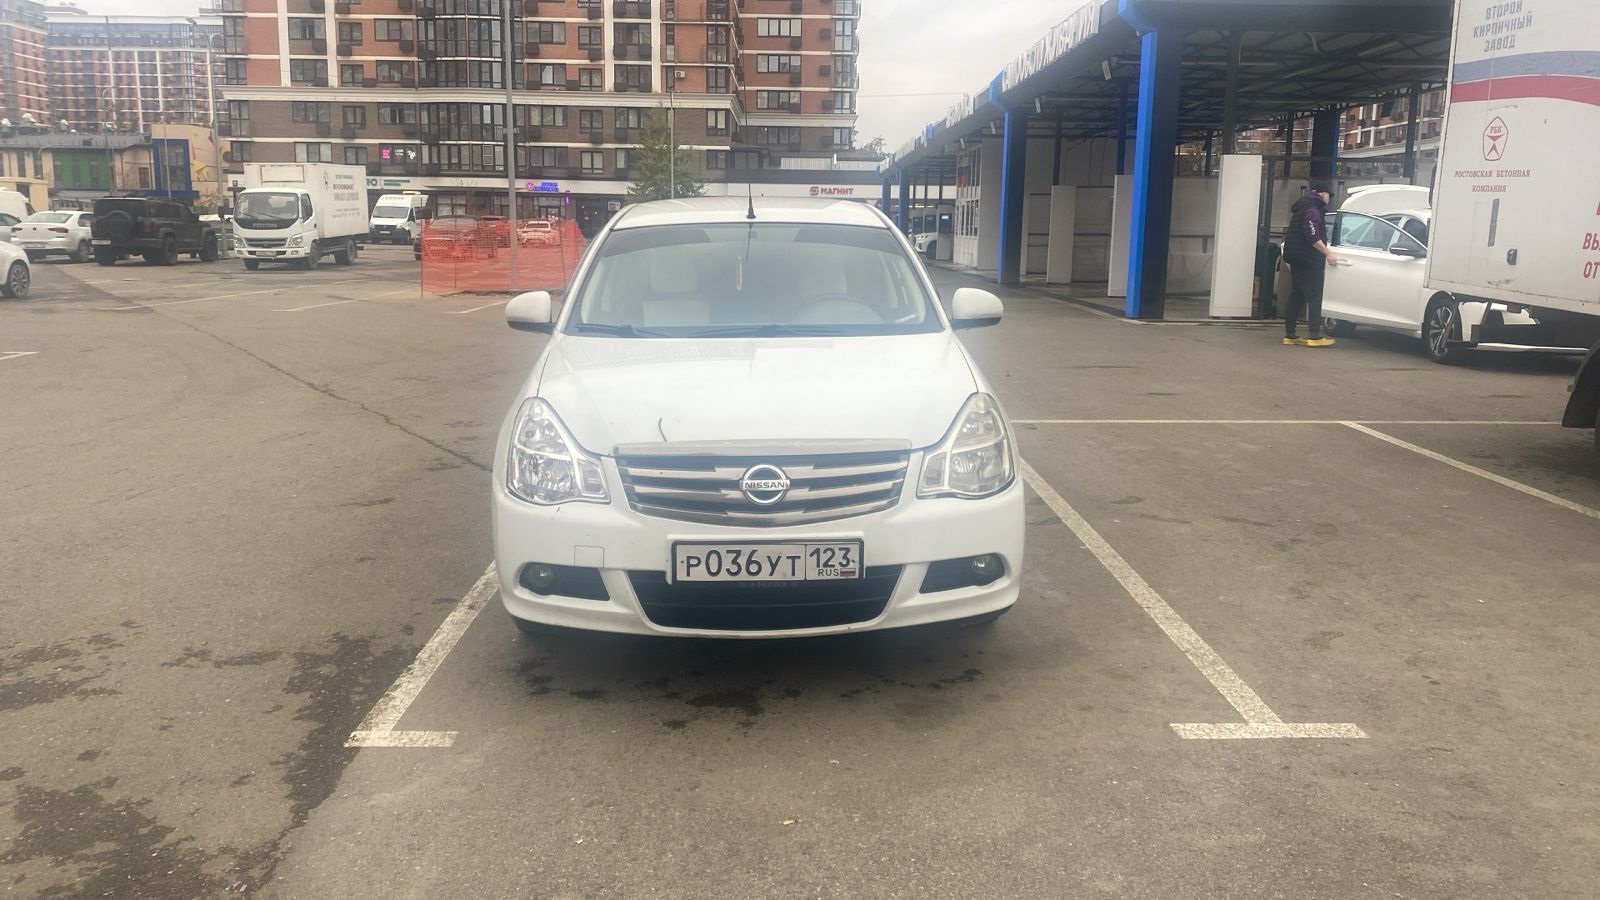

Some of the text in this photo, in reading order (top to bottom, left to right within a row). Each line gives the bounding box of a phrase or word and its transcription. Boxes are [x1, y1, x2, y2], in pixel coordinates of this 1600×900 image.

[1473, 11, 1533, 39] КИРПИЧНЫЙ
[1484, 34, 1516, 52] ЗАВОД
[1490, 126, 1502, 134] РБК
[1454, 169, 1531, 178] РОСТОВСКАЯ БЕТОННАЯ
[820, 187, 854, 195] МАГНИТ
[1472, 184, 1507, 193] КОМПАНИЯ
[744, 481, 785, 489] NISSAN
[686, 547, 851, 577] Р036УТ 123
[817, 568, 840, 577] RUS
